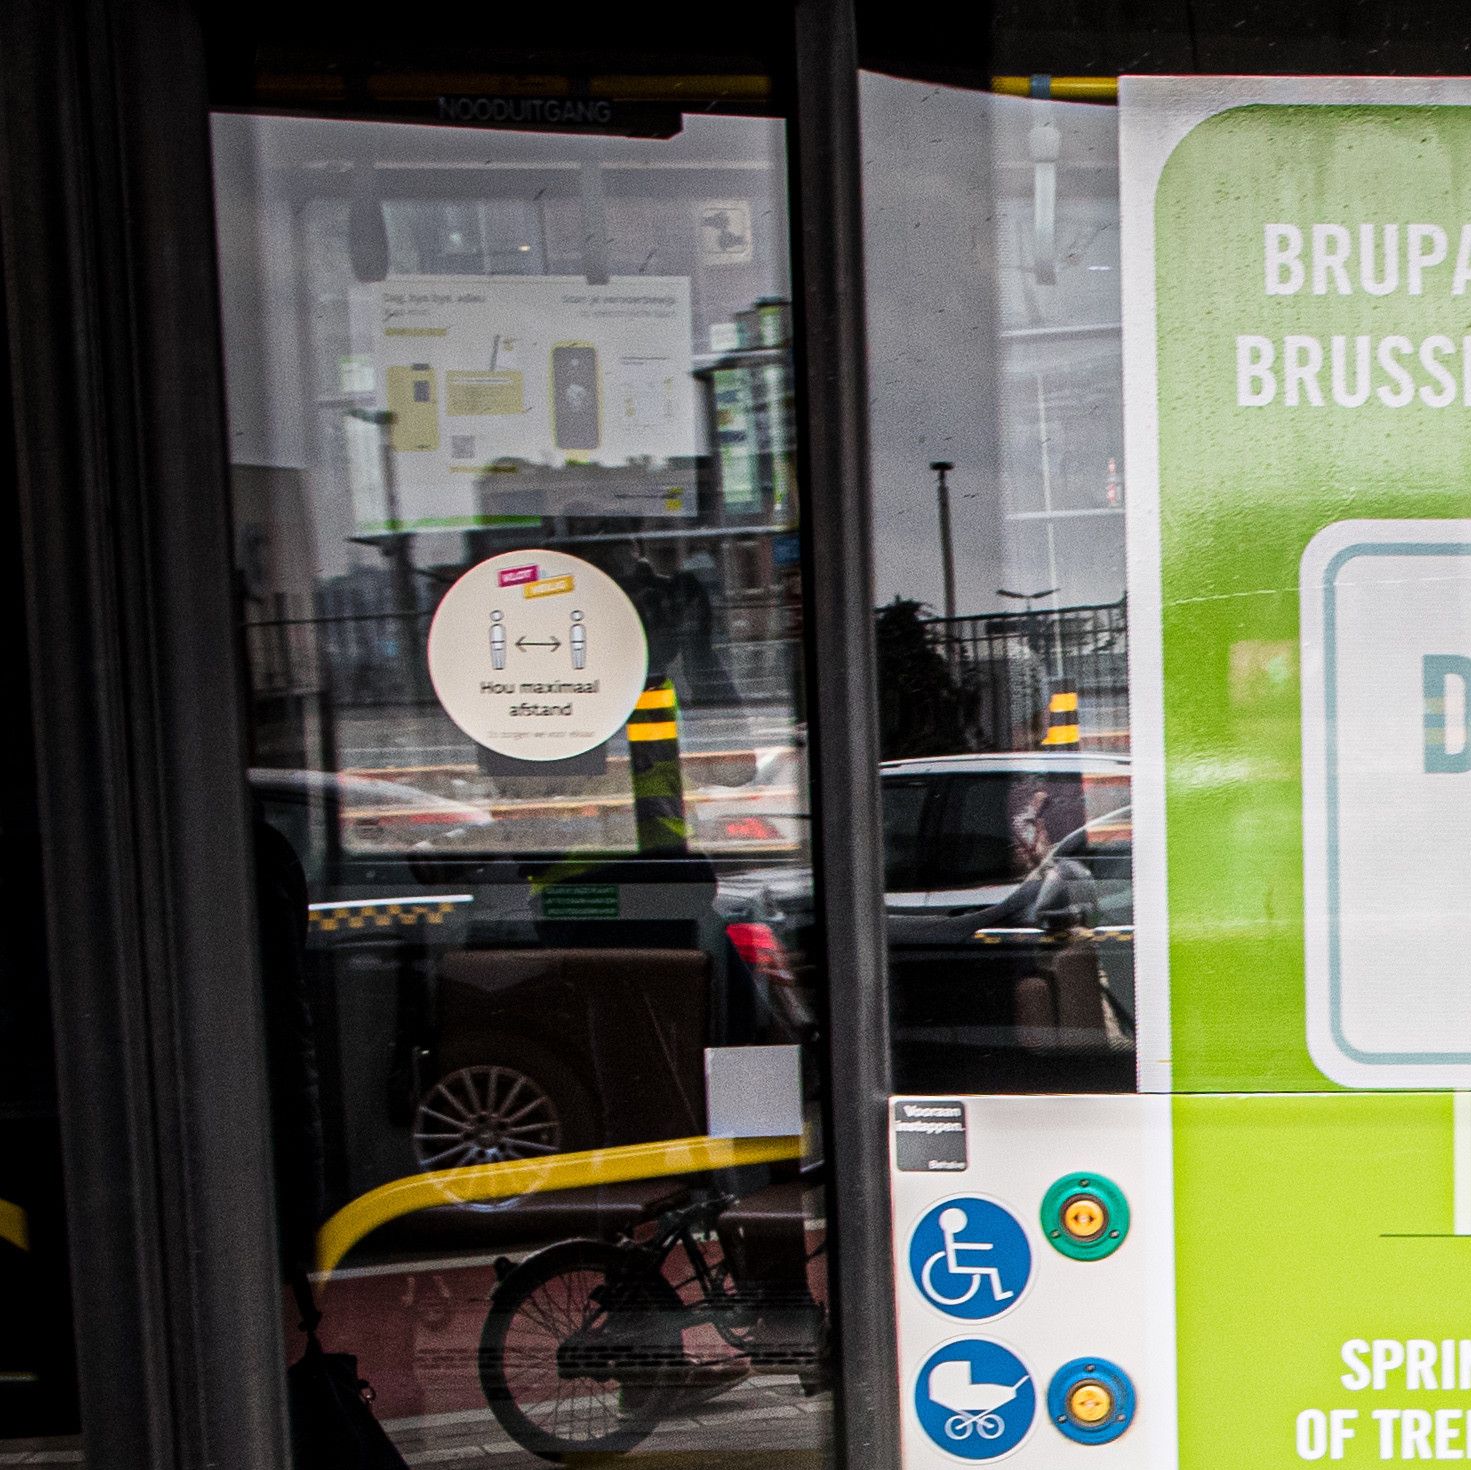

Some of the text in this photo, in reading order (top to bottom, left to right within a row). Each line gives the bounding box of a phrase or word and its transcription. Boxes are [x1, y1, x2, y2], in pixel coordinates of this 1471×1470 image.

[438, 96, 612, 123] NOODUITGANG
[479, 680, 600, 694] Hou maximaal
[509, 702, 573, 717] afstand
[903, 1104, 962, 1117] Vooraan
[1296, 1408, 1358, 1461] OF
